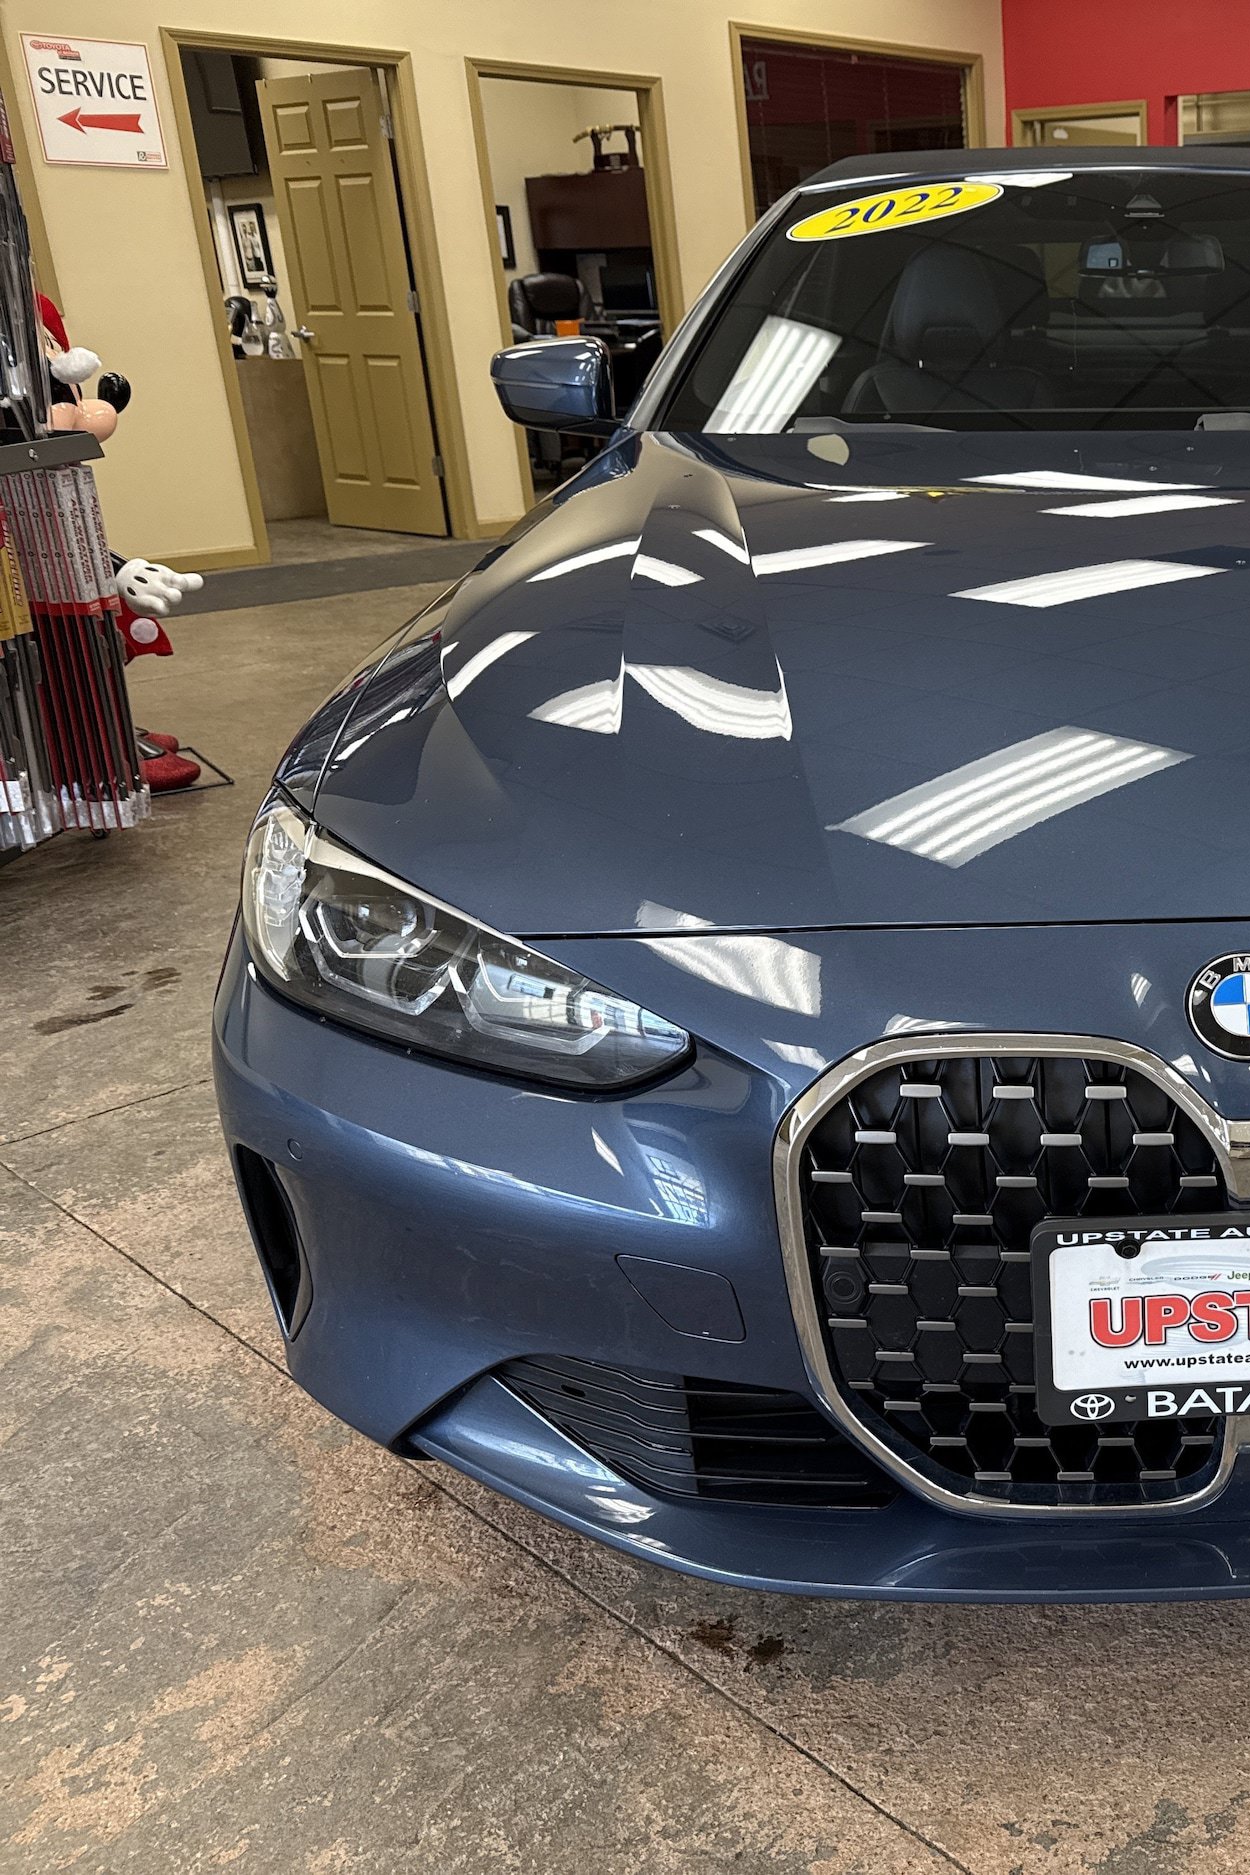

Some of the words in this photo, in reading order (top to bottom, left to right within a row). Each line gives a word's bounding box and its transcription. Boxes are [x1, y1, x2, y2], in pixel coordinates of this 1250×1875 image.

[37, 66, 147, 101] SERVICE
[824, 187, 963, 234] 2022
[1056, 1228, 1211, 1246] UPSTATE
